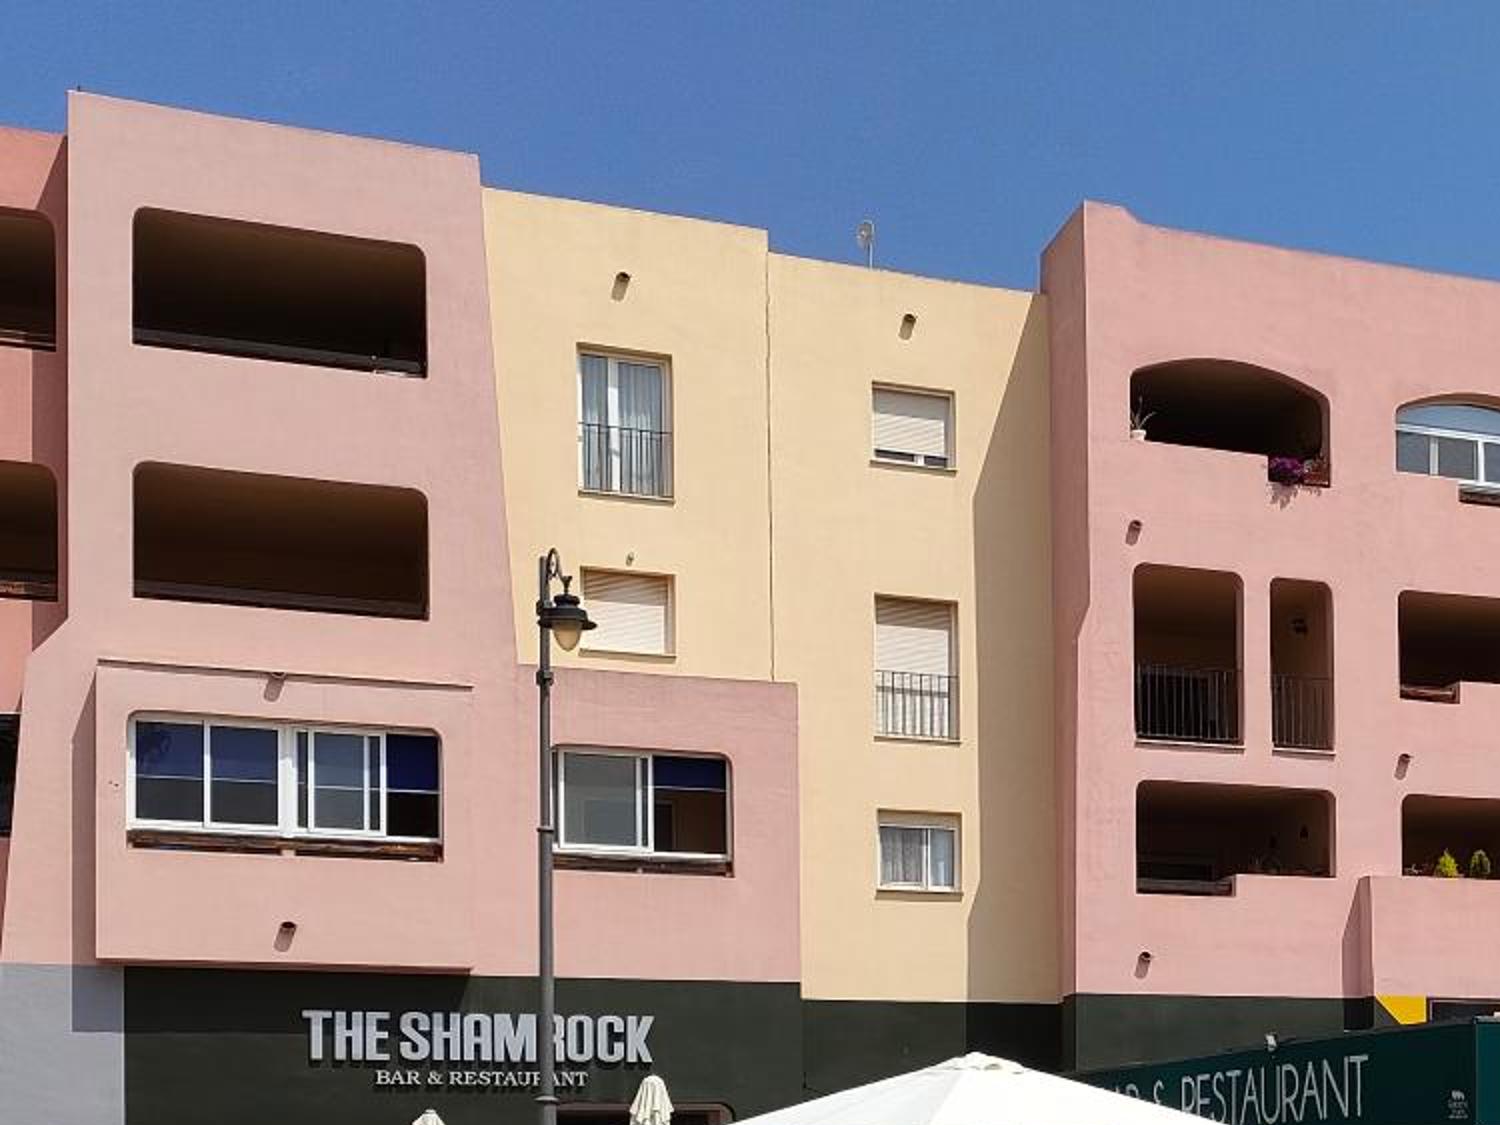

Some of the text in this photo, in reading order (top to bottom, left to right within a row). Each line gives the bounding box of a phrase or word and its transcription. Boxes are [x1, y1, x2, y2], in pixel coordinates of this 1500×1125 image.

[302, 1010, 391, 1060] THE
[375, 1070, 421, 1086] BAR
[427, 1070, 441, 1086] &
[1181, 1054, 1369, 1125] RESTAURANT
